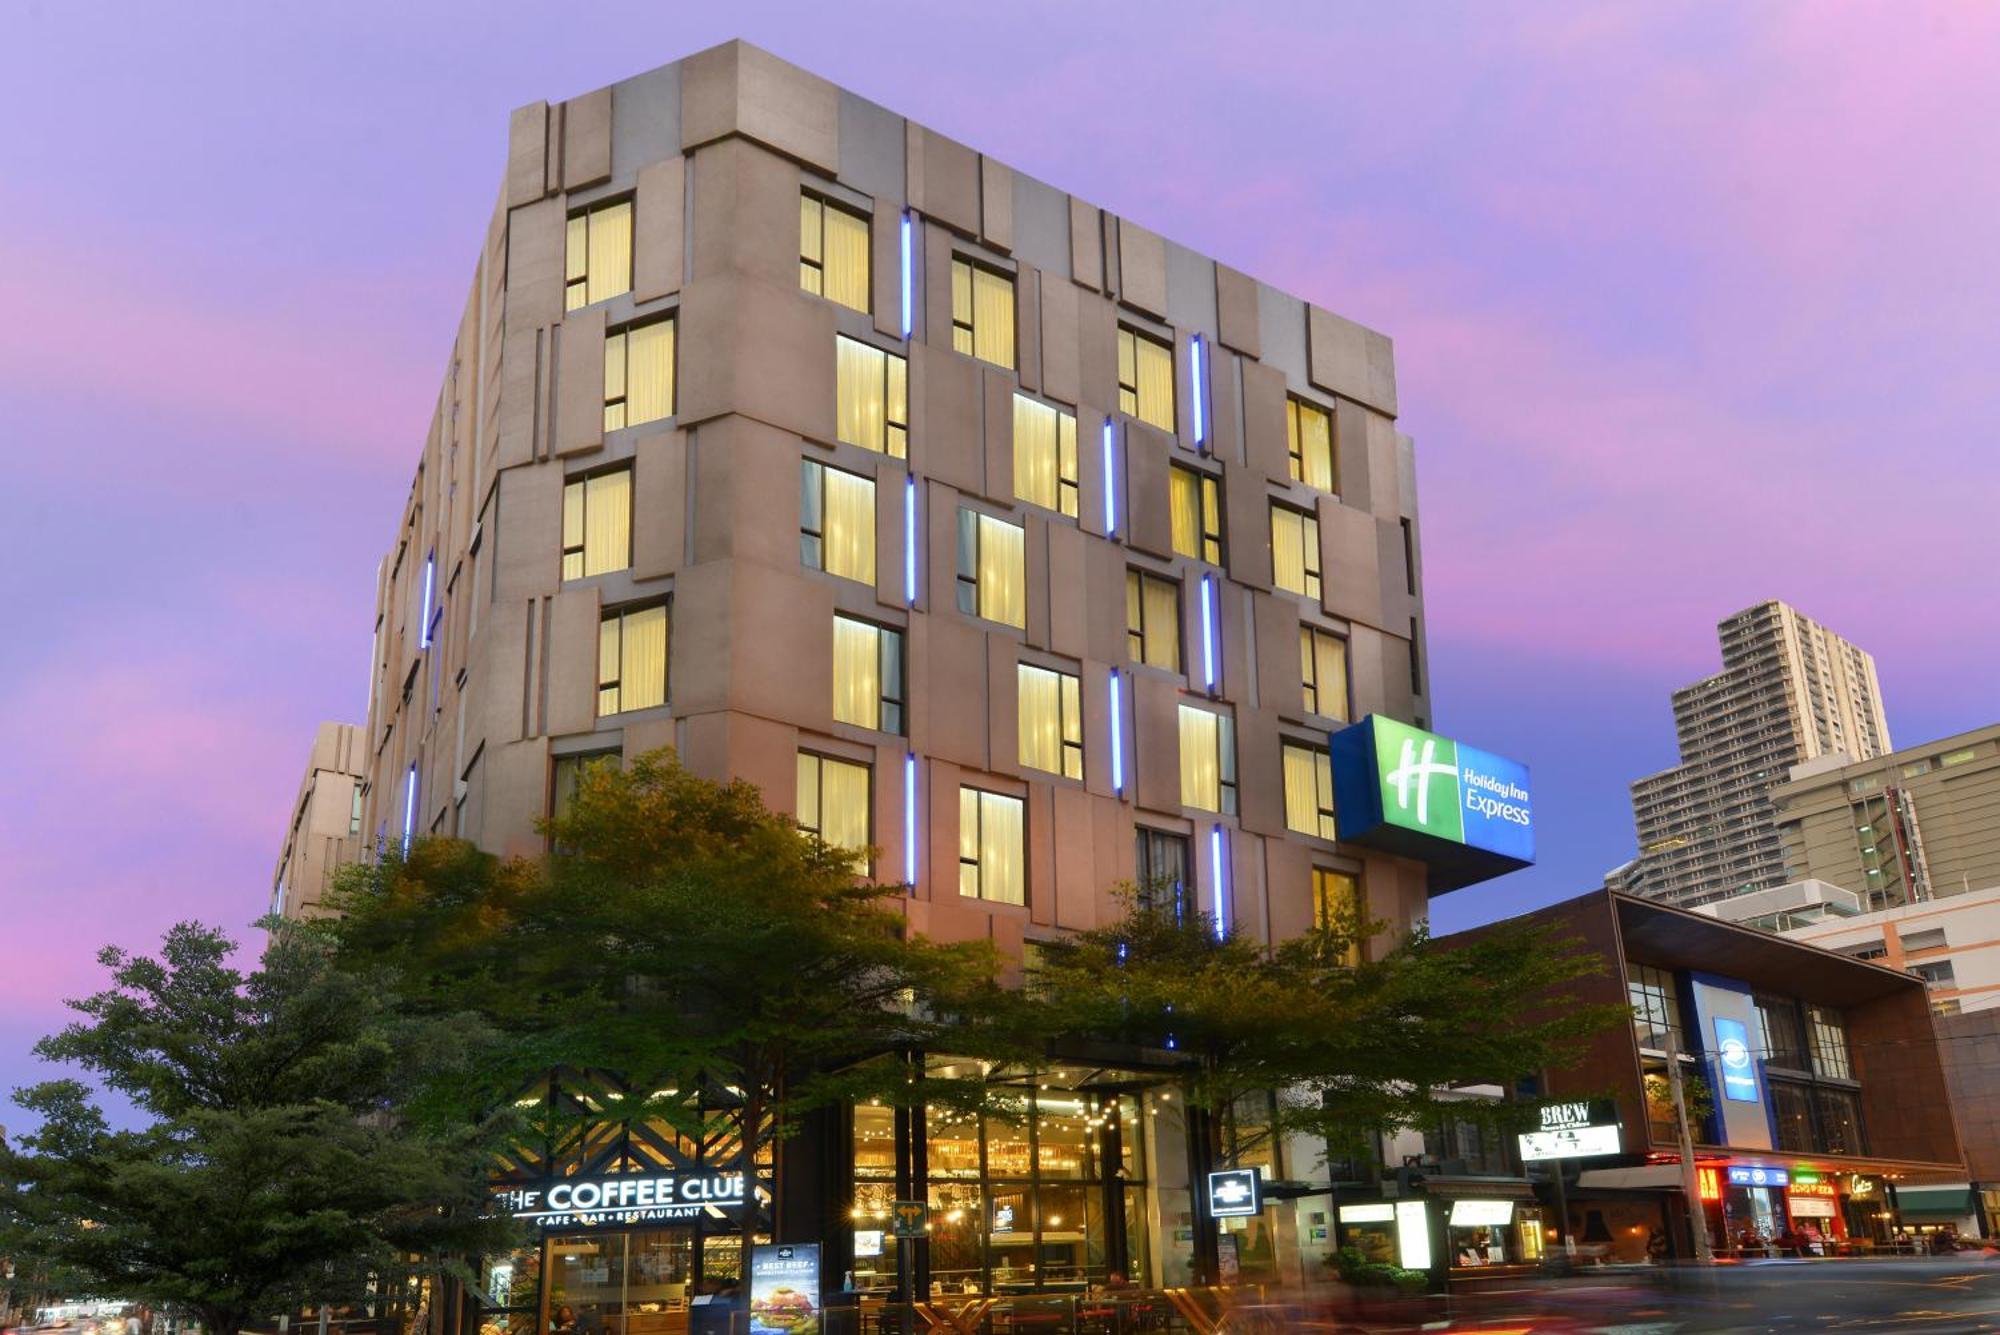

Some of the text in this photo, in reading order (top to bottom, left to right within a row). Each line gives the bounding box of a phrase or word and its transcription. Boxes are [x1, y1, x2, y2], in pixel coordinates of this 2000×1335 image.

[1466, 788, 1531, 826] Express
[1540, 1102, 1590, 1124] BREW
[547, 1178, 675, 1211] COFFEE
[536, 1207, 701, 1226] CAFE BAR RESTAURANT
